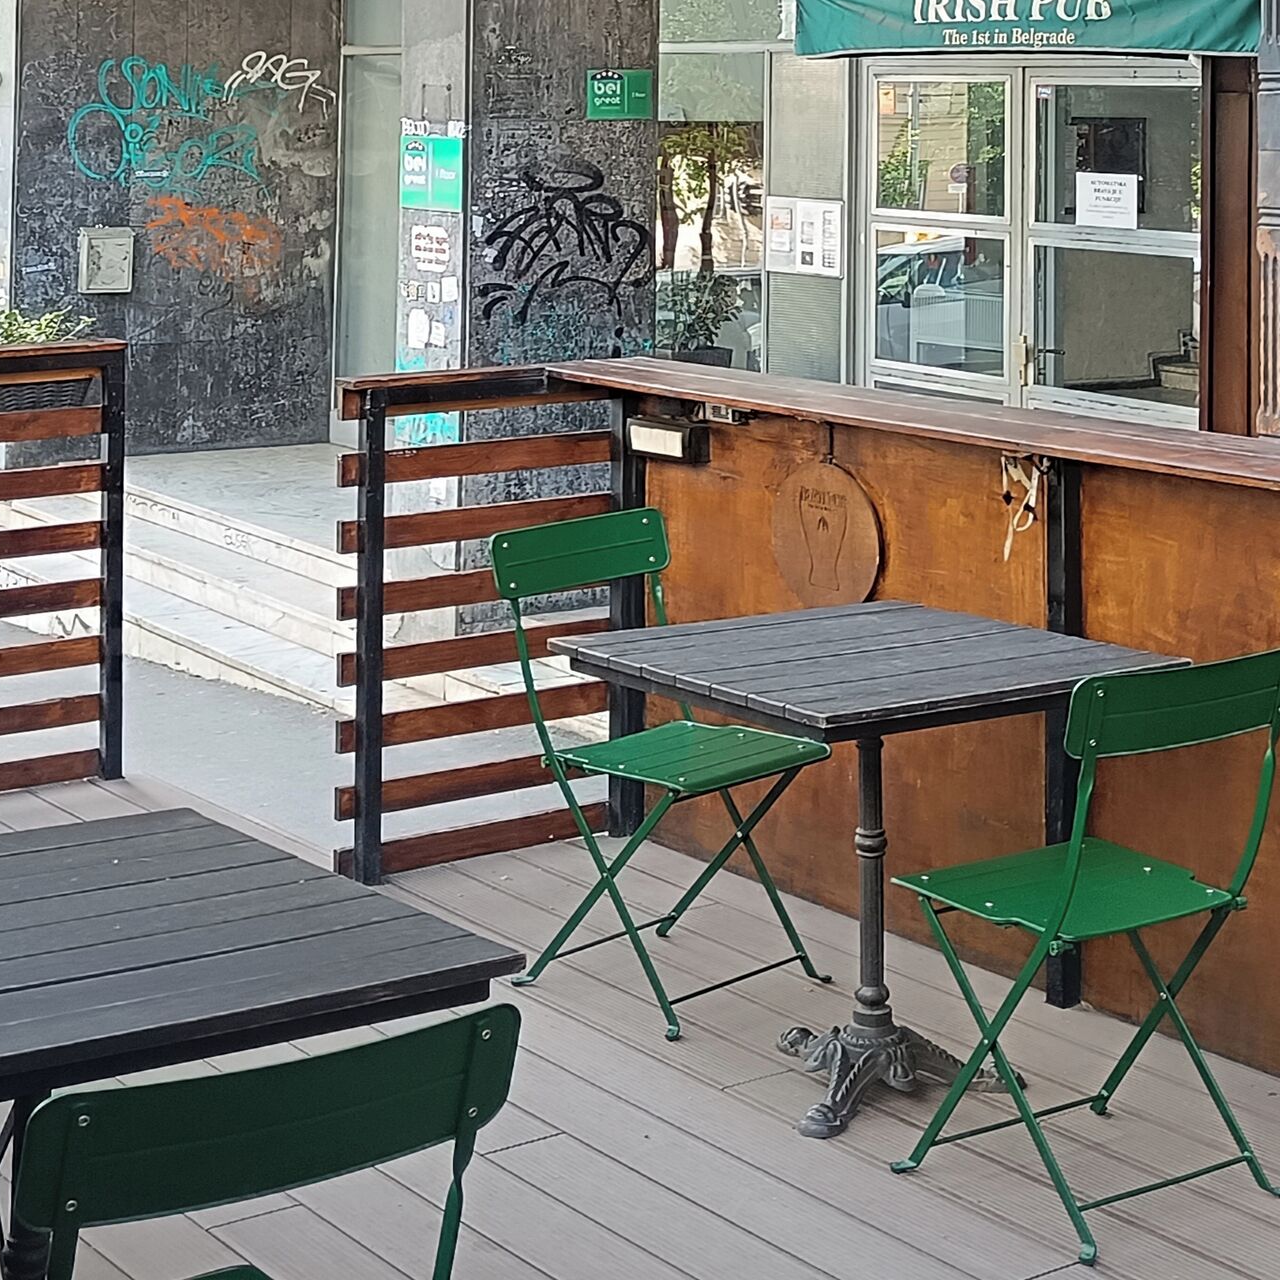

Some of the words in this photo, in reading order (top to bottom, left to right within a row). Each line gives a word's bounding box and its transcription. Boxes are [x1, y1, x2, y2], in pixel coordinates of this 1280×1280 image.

[942, 28, 968, 46] The
[971, 28, 990, 46] 1st
[993, 27, 1008, 45] in
[1011, 26, 1076, 48] Belgrade
